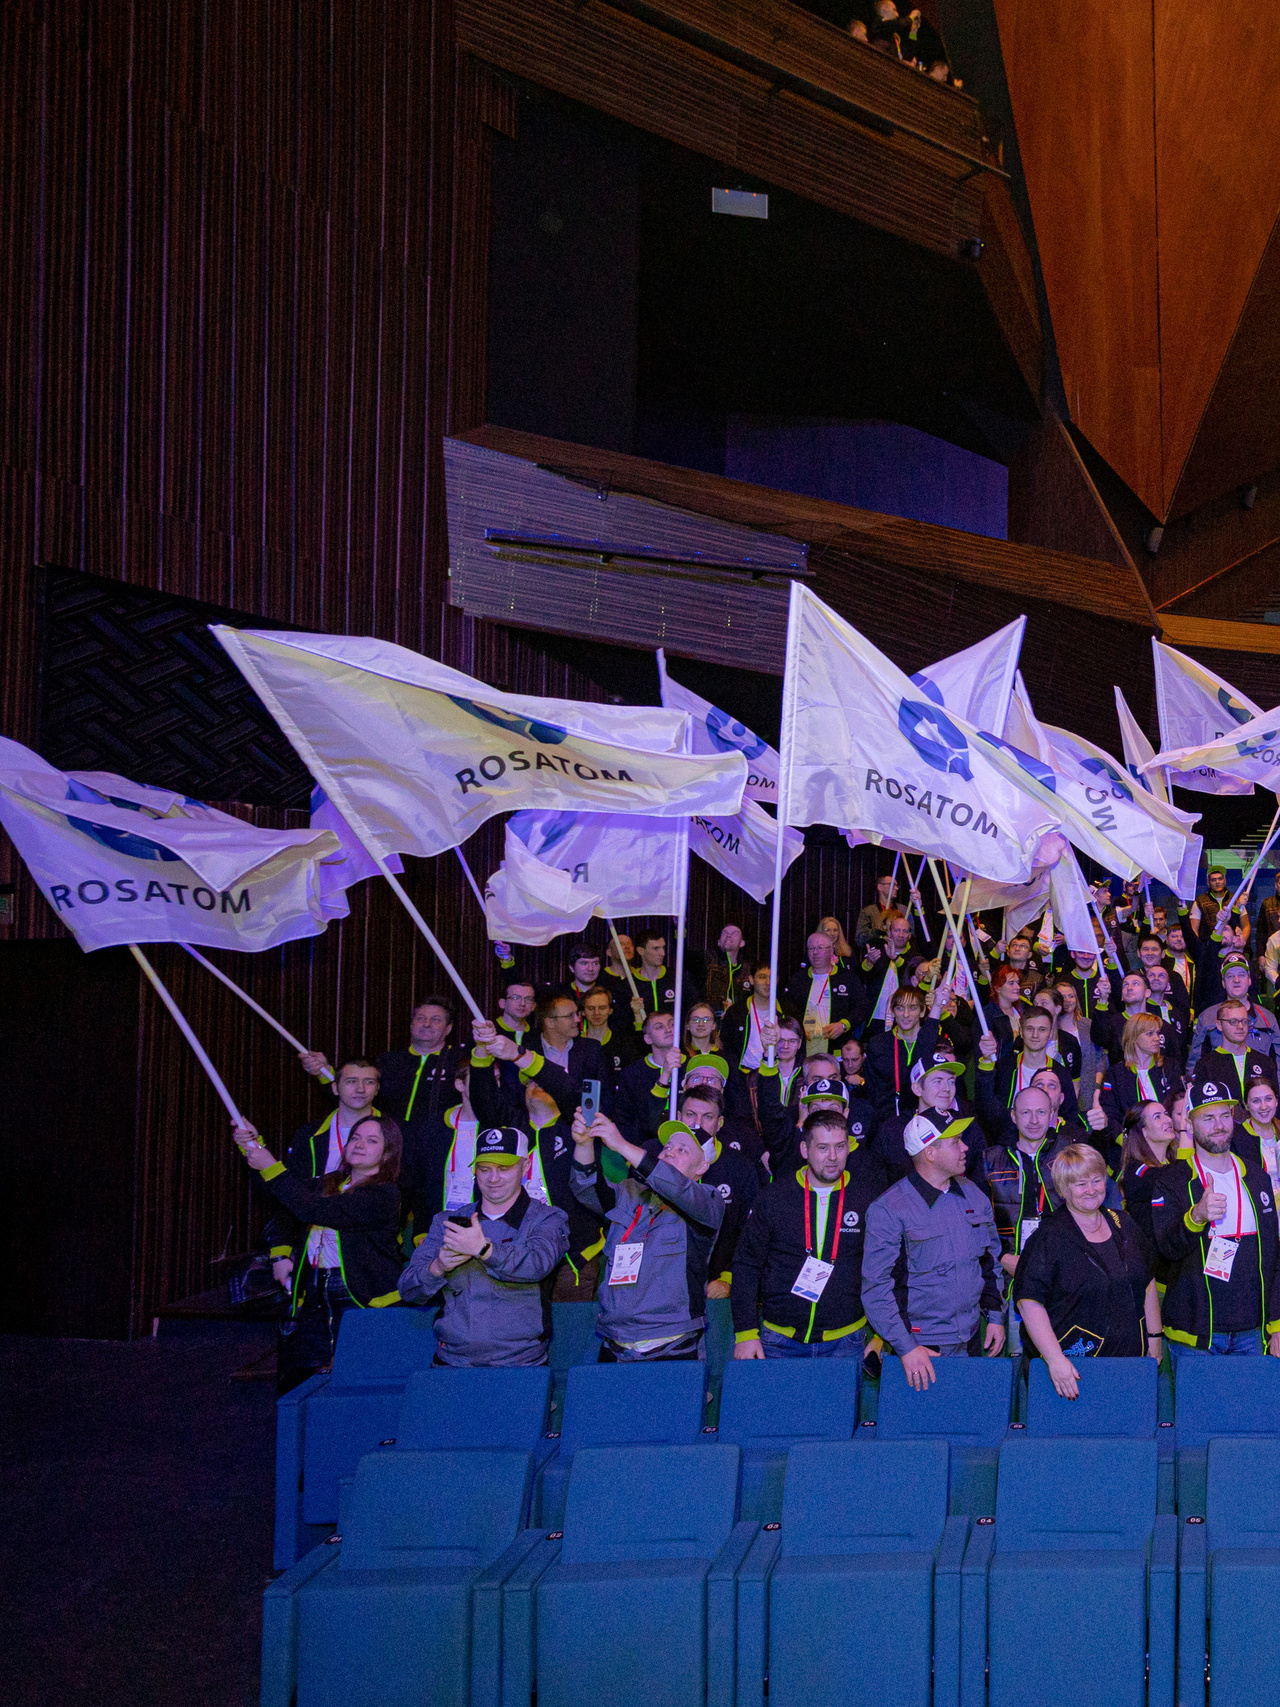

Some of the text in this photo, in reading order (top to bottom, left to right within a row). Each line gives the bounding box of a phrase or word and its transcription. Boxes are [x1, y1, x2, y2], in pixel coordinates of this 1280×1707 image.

[455, 750, 634, 794] ROSATOM
[865, 769, 998, 839] ROSATOM
[50, 878, 252, 914] ROSATOM
